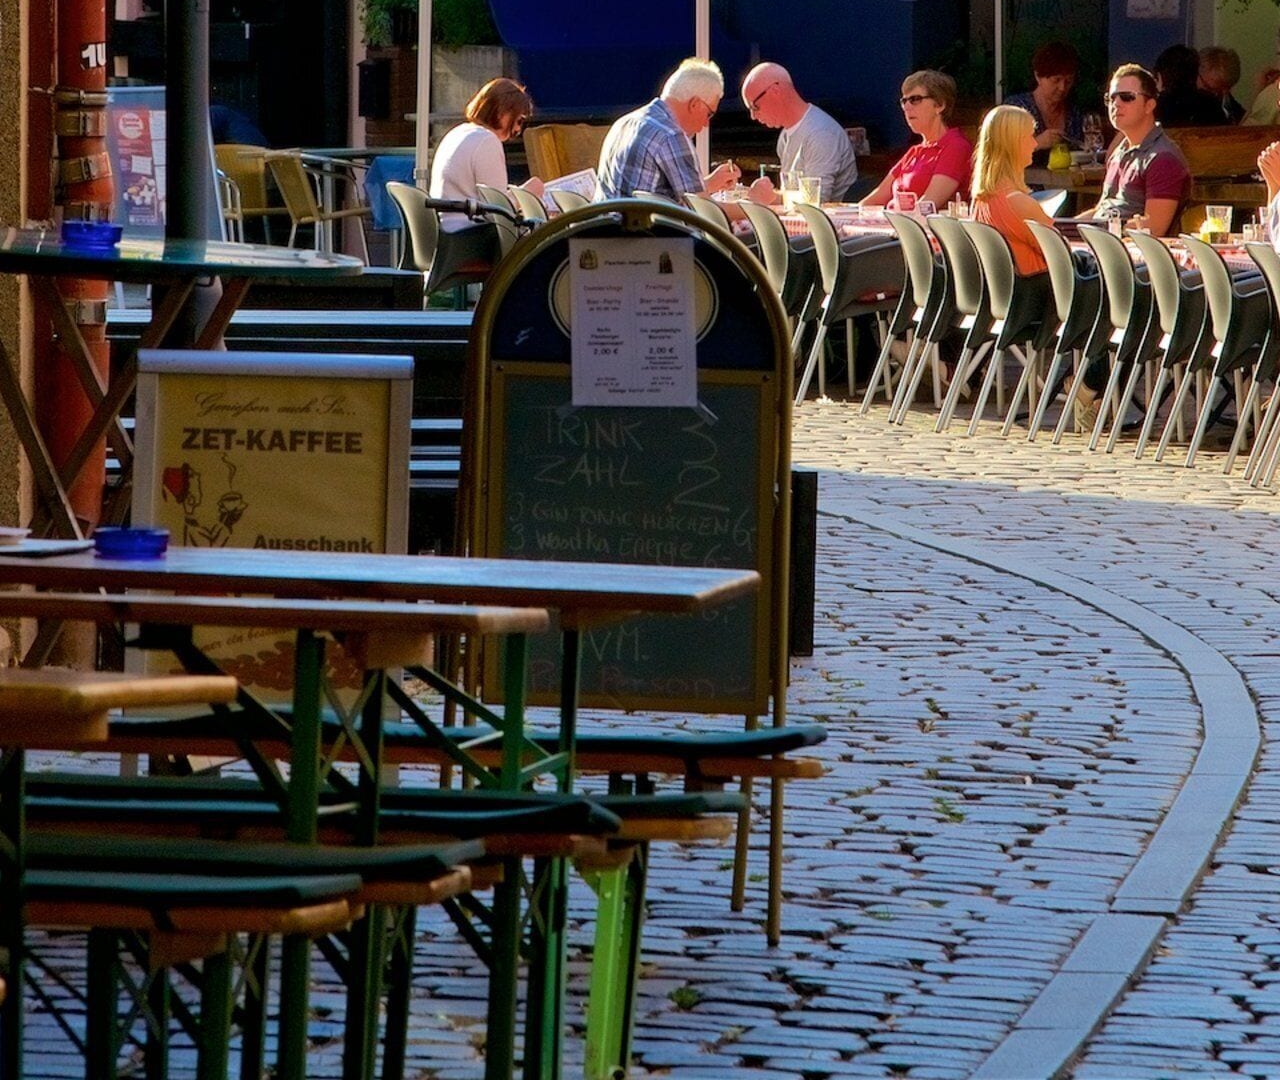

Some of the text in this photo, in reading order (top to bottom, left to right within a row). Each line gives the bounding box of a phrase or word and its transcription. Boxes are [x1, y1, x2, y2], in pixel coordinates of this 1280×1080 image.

[182, 427, 363, 454] ZET-KAFFEE
[532, 453, 652, 487] ZAHL
[253, 535, 374, 554] Ausschank
